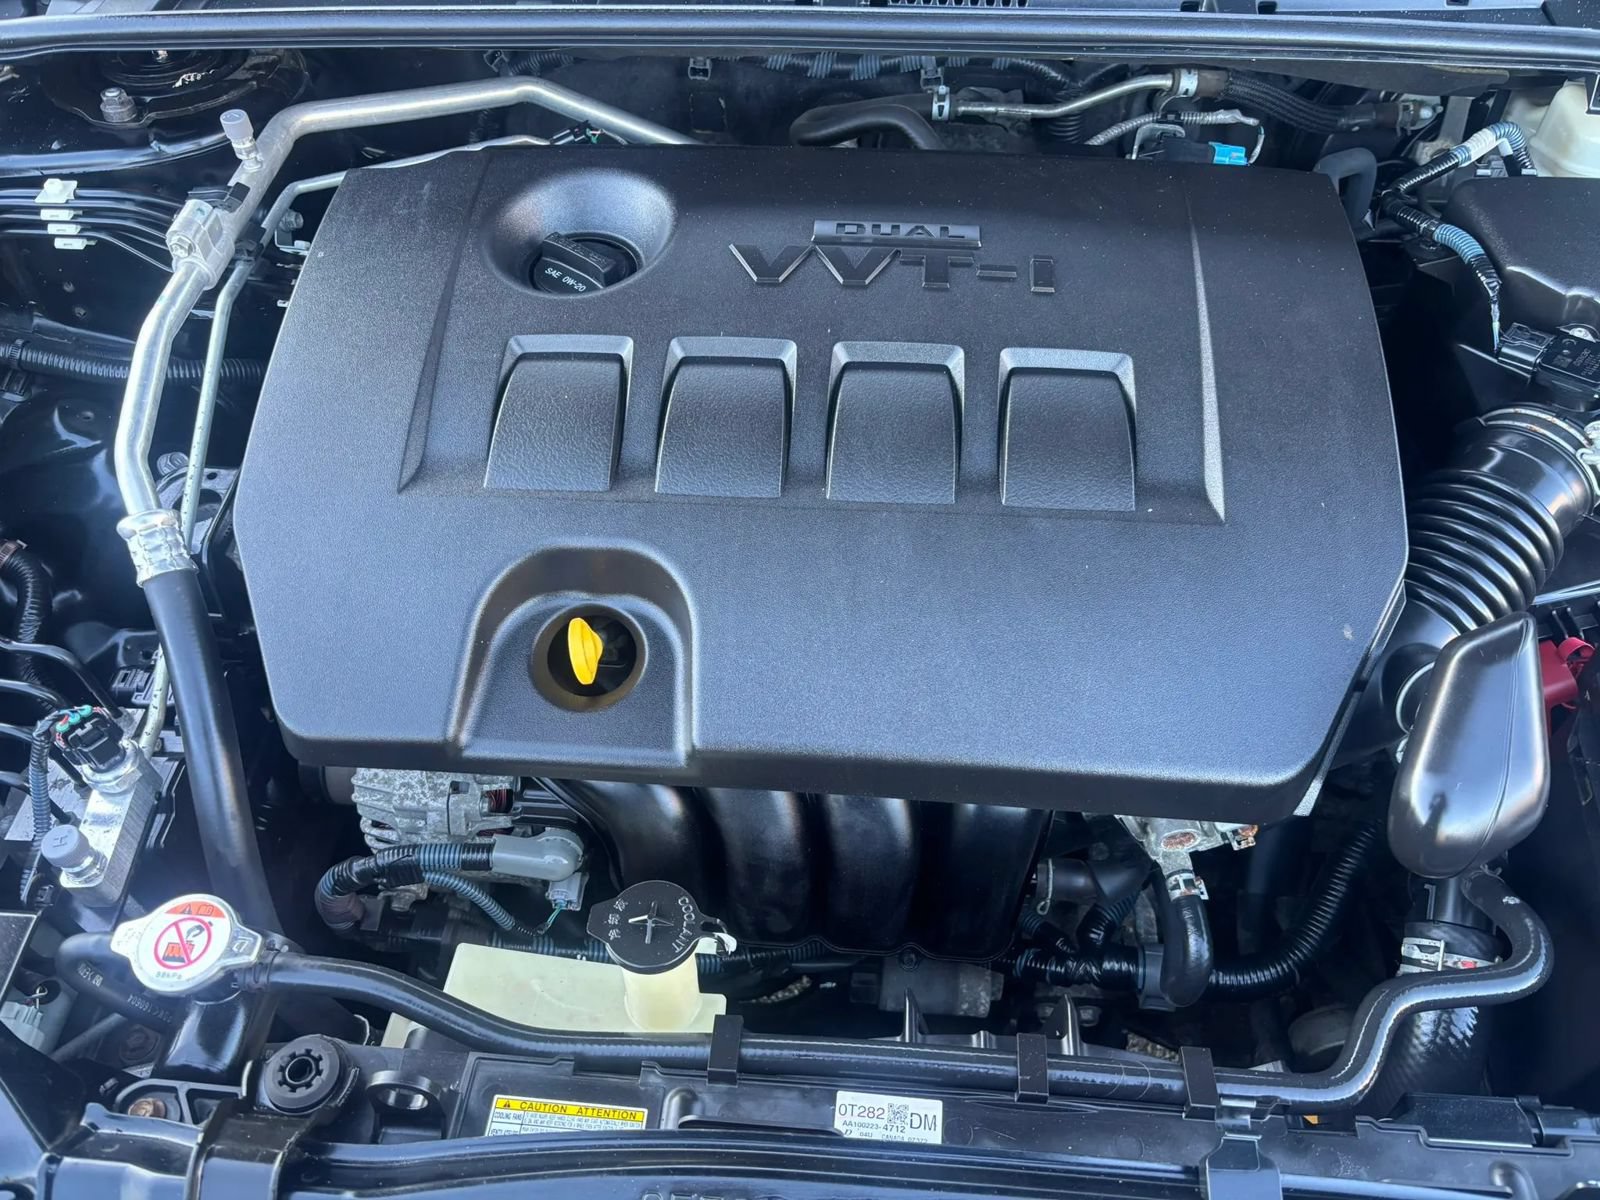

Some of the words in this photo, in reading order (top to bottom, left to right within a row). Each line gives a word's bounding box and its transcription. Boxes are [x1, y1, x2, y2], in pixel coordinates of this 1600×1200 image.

[836, 222, 966, 239] DUAL
[545, 267, 562, 279] SAE
[562, 276, 587, 292] 0W-20
[672, 895, 696, 954] COOLANT
[520, 1101, 567, 1113] CAUTION
[577, 1106, 637, 1120] ATTENTION
[910, 1112, 937, 1132] DM
